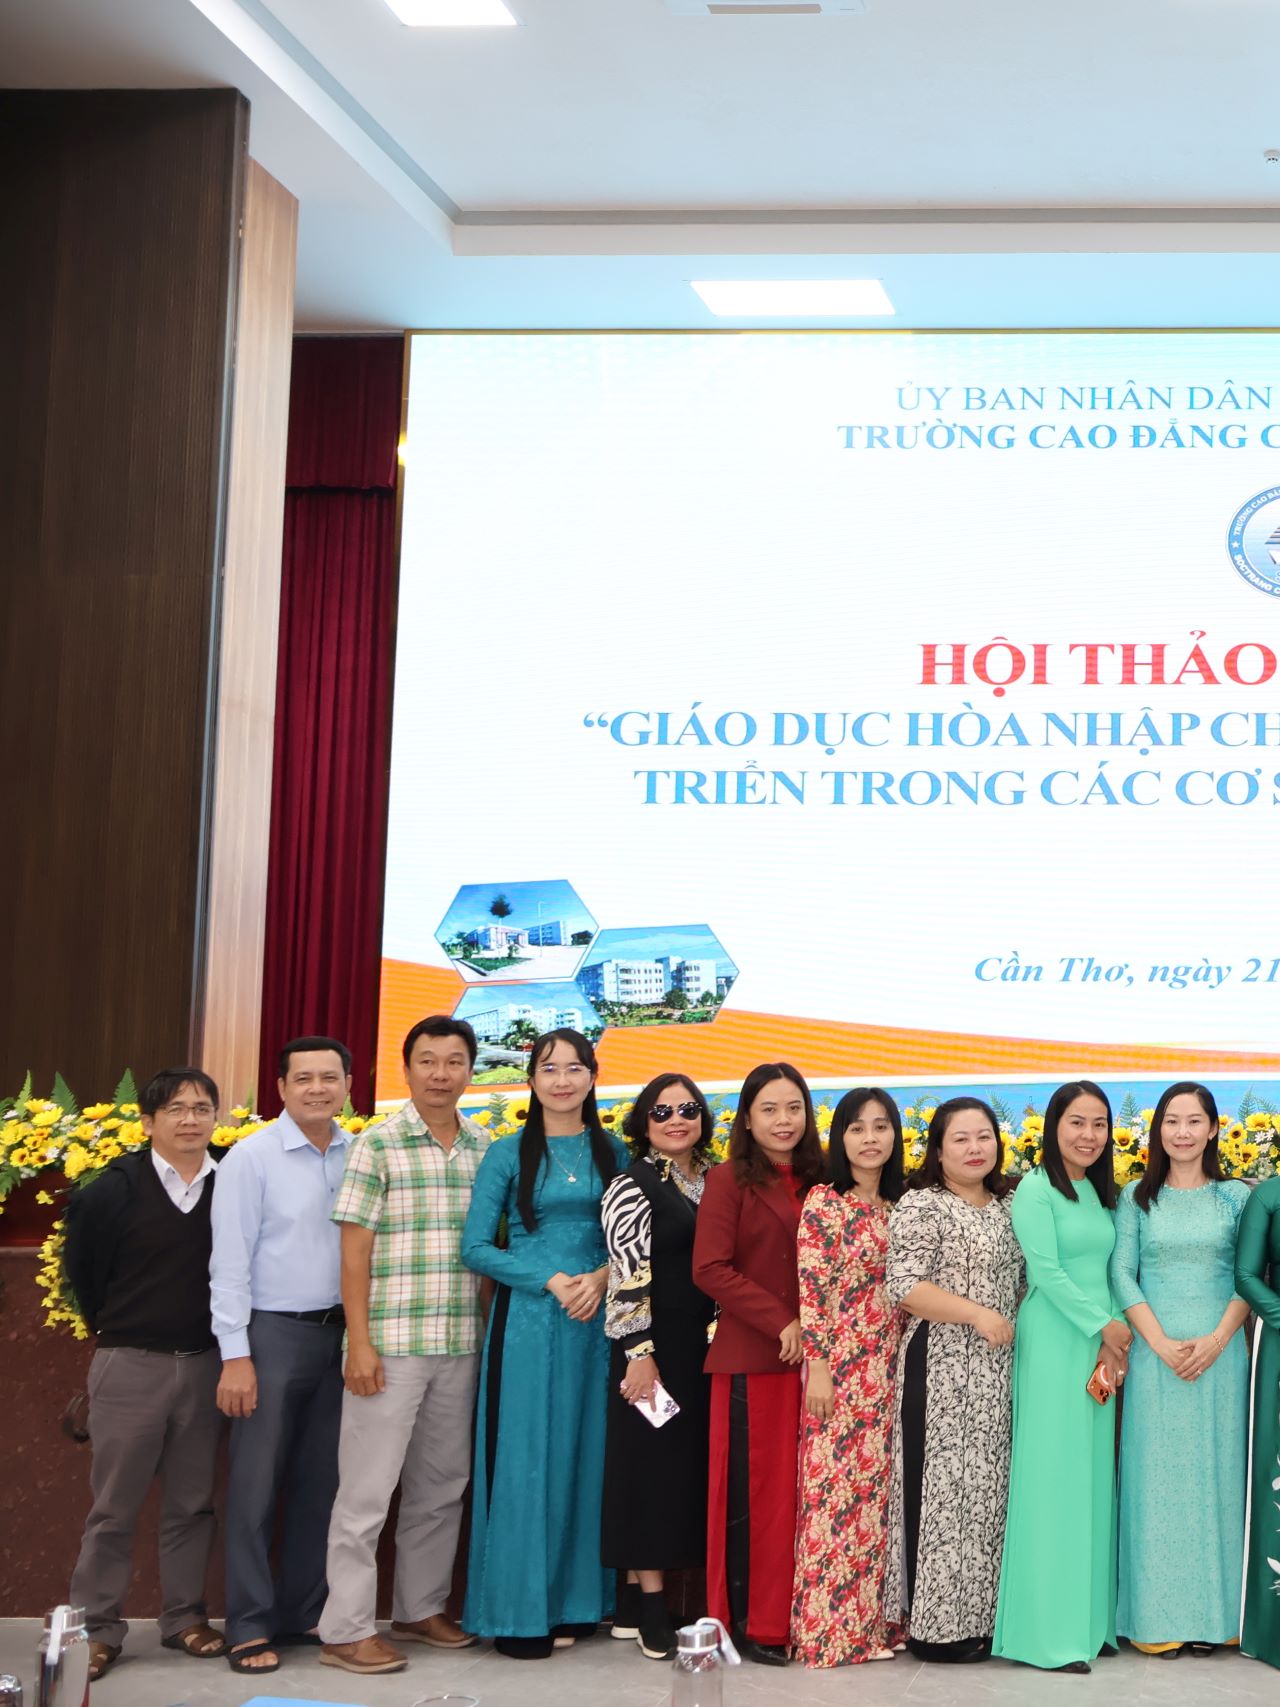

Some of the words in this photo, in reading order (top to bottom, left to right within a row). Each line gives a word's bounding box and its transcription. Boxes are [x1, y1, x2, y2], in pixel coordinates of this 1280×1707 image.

[897, 381, 952, 410] ỦY
[963, 387, 1045, 410] BAN
[1059, 380, 1173, 410] NHÂN
[1187, 379, 1272, 410] DÂN
[837, 418, 1016, 449] TRƯỜNG
[1028, 424, 1118, 449] CAO
[1251, 495, 1269, 508] CAO
[916, 636, 1052, 698] HỘI
[1069, 630, 1277, 686] THẢO
[770, 711, 892, 756] DỤC
[904, 701, 1032, 748] HÒA
[1040, 707, 1201, 756] NHẬP
[633, 760, 808, 806] TRIỂN
[821, 770, 1027, 806] TRONG
[1040, 760, 1161, 806] CÁC
[1175, 768, 1262, 806] CƠ
[975, 951, 1043, 982] Cần
[1059, 957, 1134, 987] Thơ,
[1148, 958, 1232, 990] ngày
[1241, 957, 1280, 983] 21
